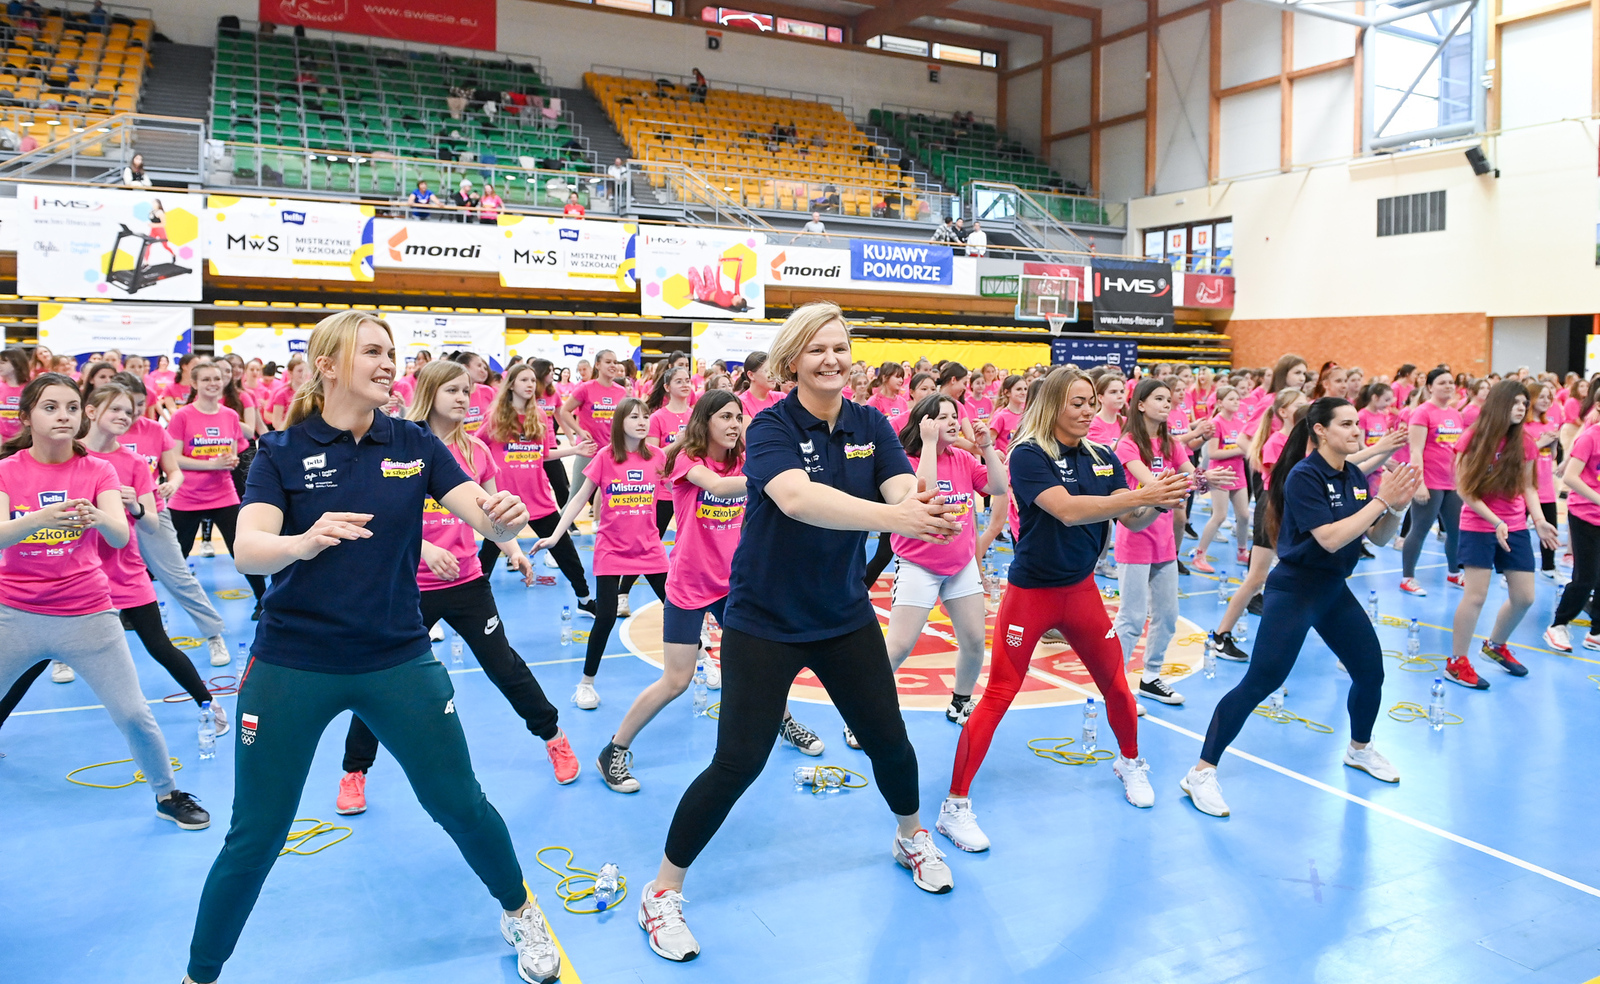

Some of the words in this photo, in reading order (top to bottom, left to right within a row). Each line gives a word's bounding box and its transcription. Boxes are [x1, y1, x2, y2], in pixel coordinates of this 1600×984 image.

[363, 4, 478, 27] www.swiecie.eu
[708, 37, 720, 50] D
[929, 71, 938, 82] E
[43, 199, 90, 209] HMS
[227, 233, 279, 252] MwS
[295, 237, 351, 247] MISTRZYNIE
[308, 247, 356, 255] SZKOŁACH
[404, 244, 481, 259] mondi
[571, 252, 617, 261] MISTRZYNIE
[863, 244, 929, 264] KUJAWY
[514, 249, 557, 266] MwS
[581, 261, 621, 269] SZKOŁACH
[783, 264, 841, 279] mondi
[863, 262, 941, 282] POMORZE
[1104, 277, 1156, 294] HMS
[1100, 315, 1164, 327] www.hms-fitness.pl
[43, 494, 63, 503] bella
[702, 508, 711, 516] w
